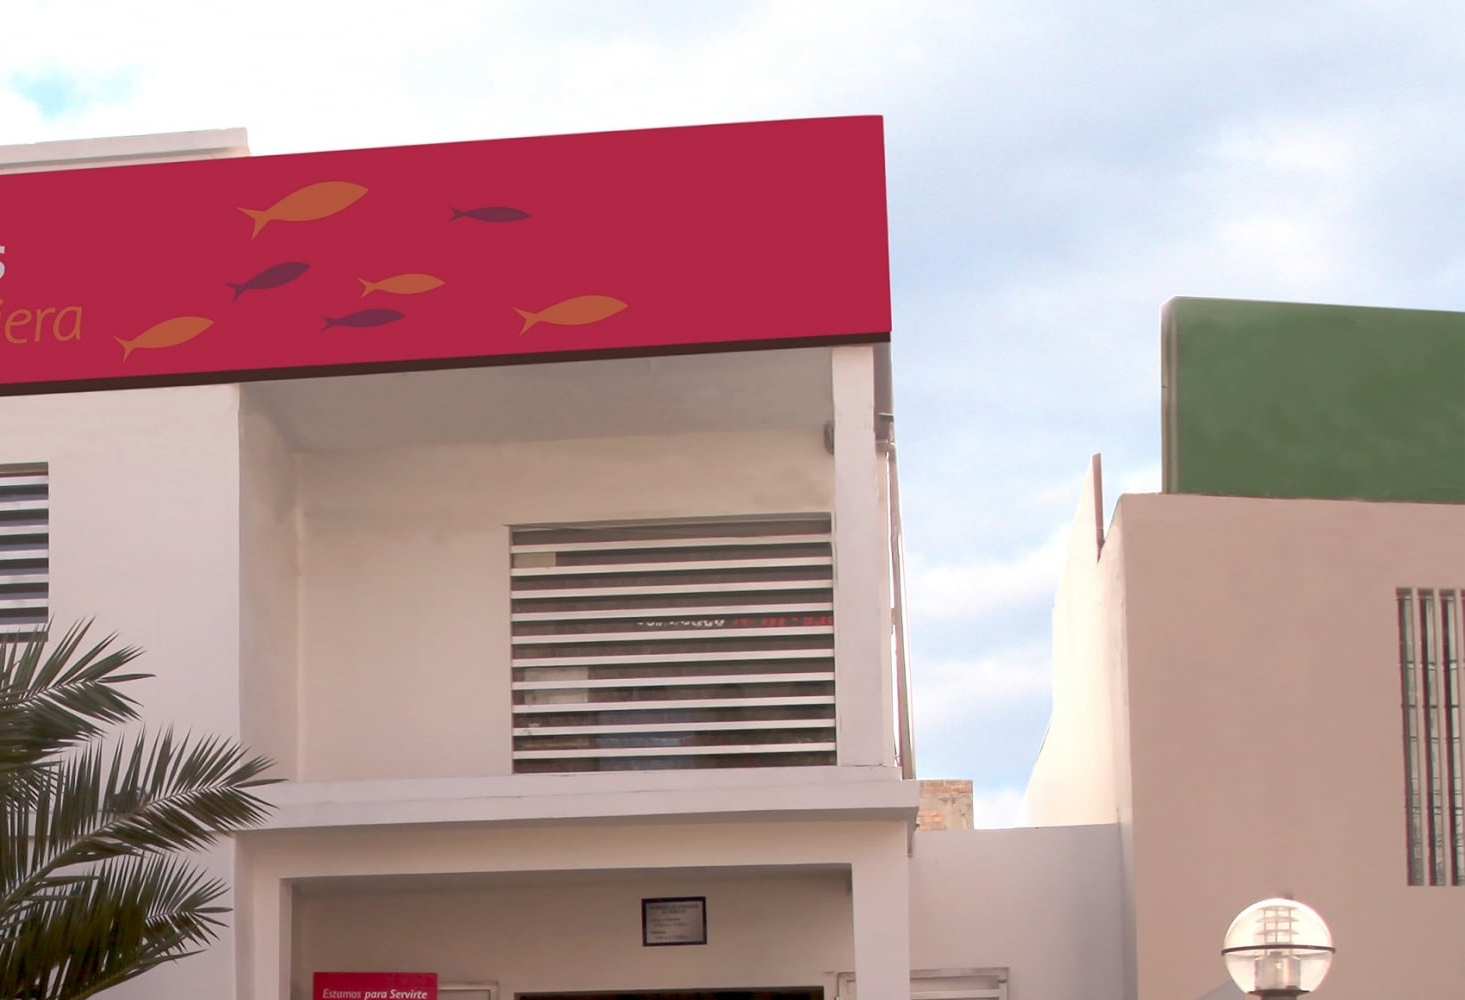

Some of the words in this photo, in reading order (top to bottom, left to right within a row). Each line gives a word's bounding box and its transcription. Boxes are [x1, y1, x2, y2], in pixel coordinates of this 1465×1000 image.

[322, 988, 361, 999] Estamos
[364, 990, 388, 1000] para
[390, 988, 428, 1000] Servirte
